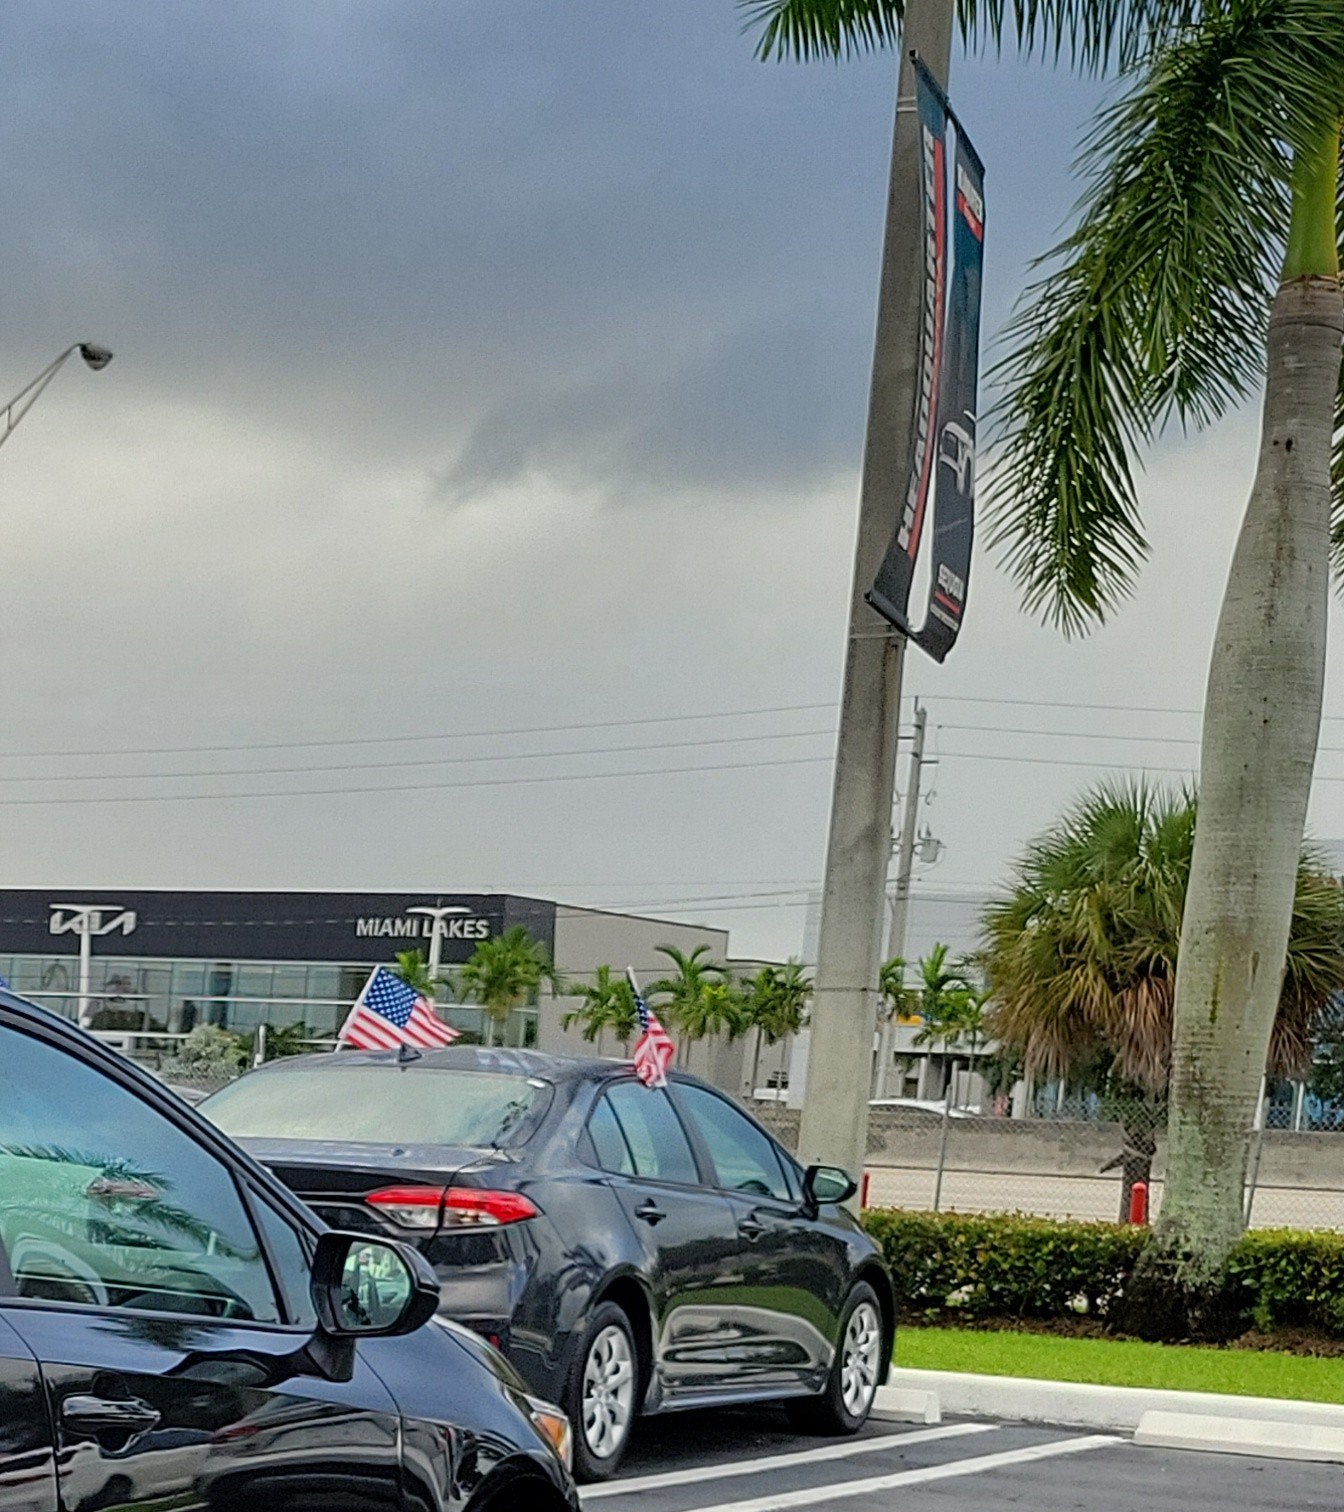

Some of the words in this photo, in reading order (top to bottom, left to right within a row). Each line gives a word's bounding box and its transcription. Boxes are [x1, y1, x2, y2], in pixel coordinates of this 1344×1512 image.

[49, 911, 137, 936] KIA
[355, 917, 419, 938] MIAMI
[422, 917, 490, 939] LAKES
